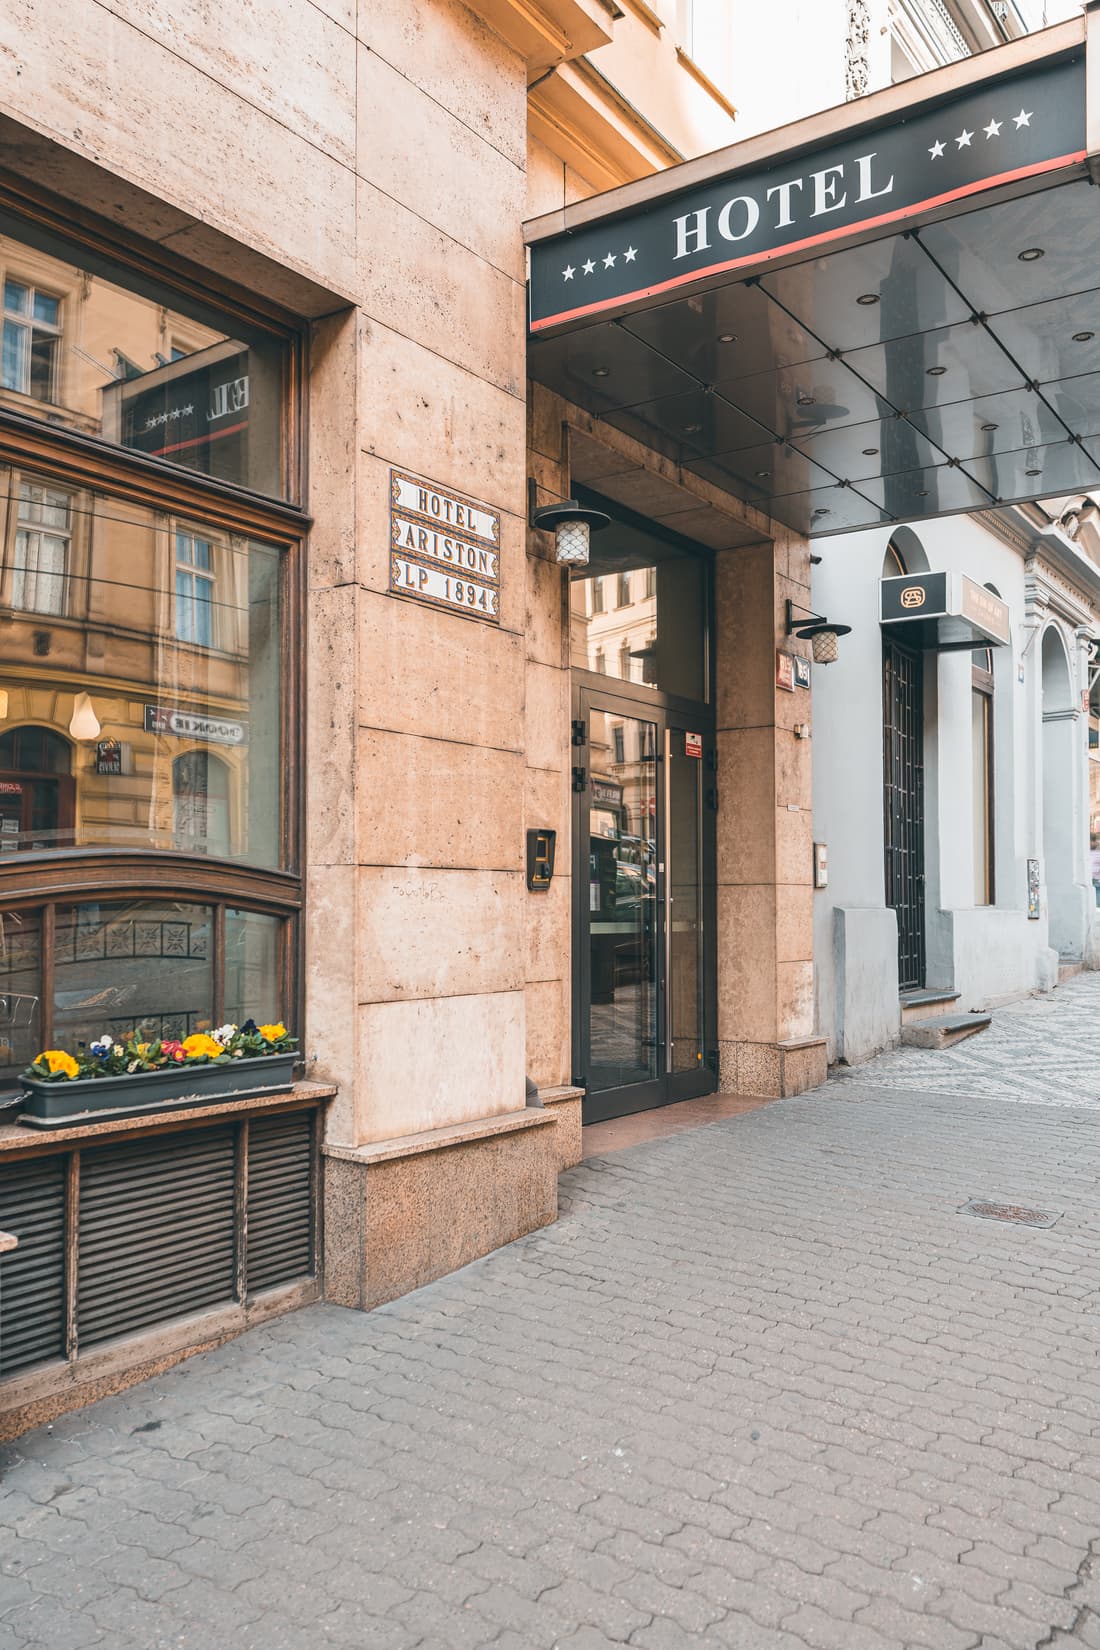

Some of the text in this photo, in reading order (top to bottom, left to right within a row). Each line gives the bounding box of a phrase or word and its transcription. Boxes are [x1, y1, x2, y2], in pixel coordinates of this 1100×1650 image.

[672, 153, 894, 260] HOTEL
[418, 489, 477, 532] HOTEL
[405, 525, 488, 572] ARISTON
[405, 563, 488, 610] LP 1894
